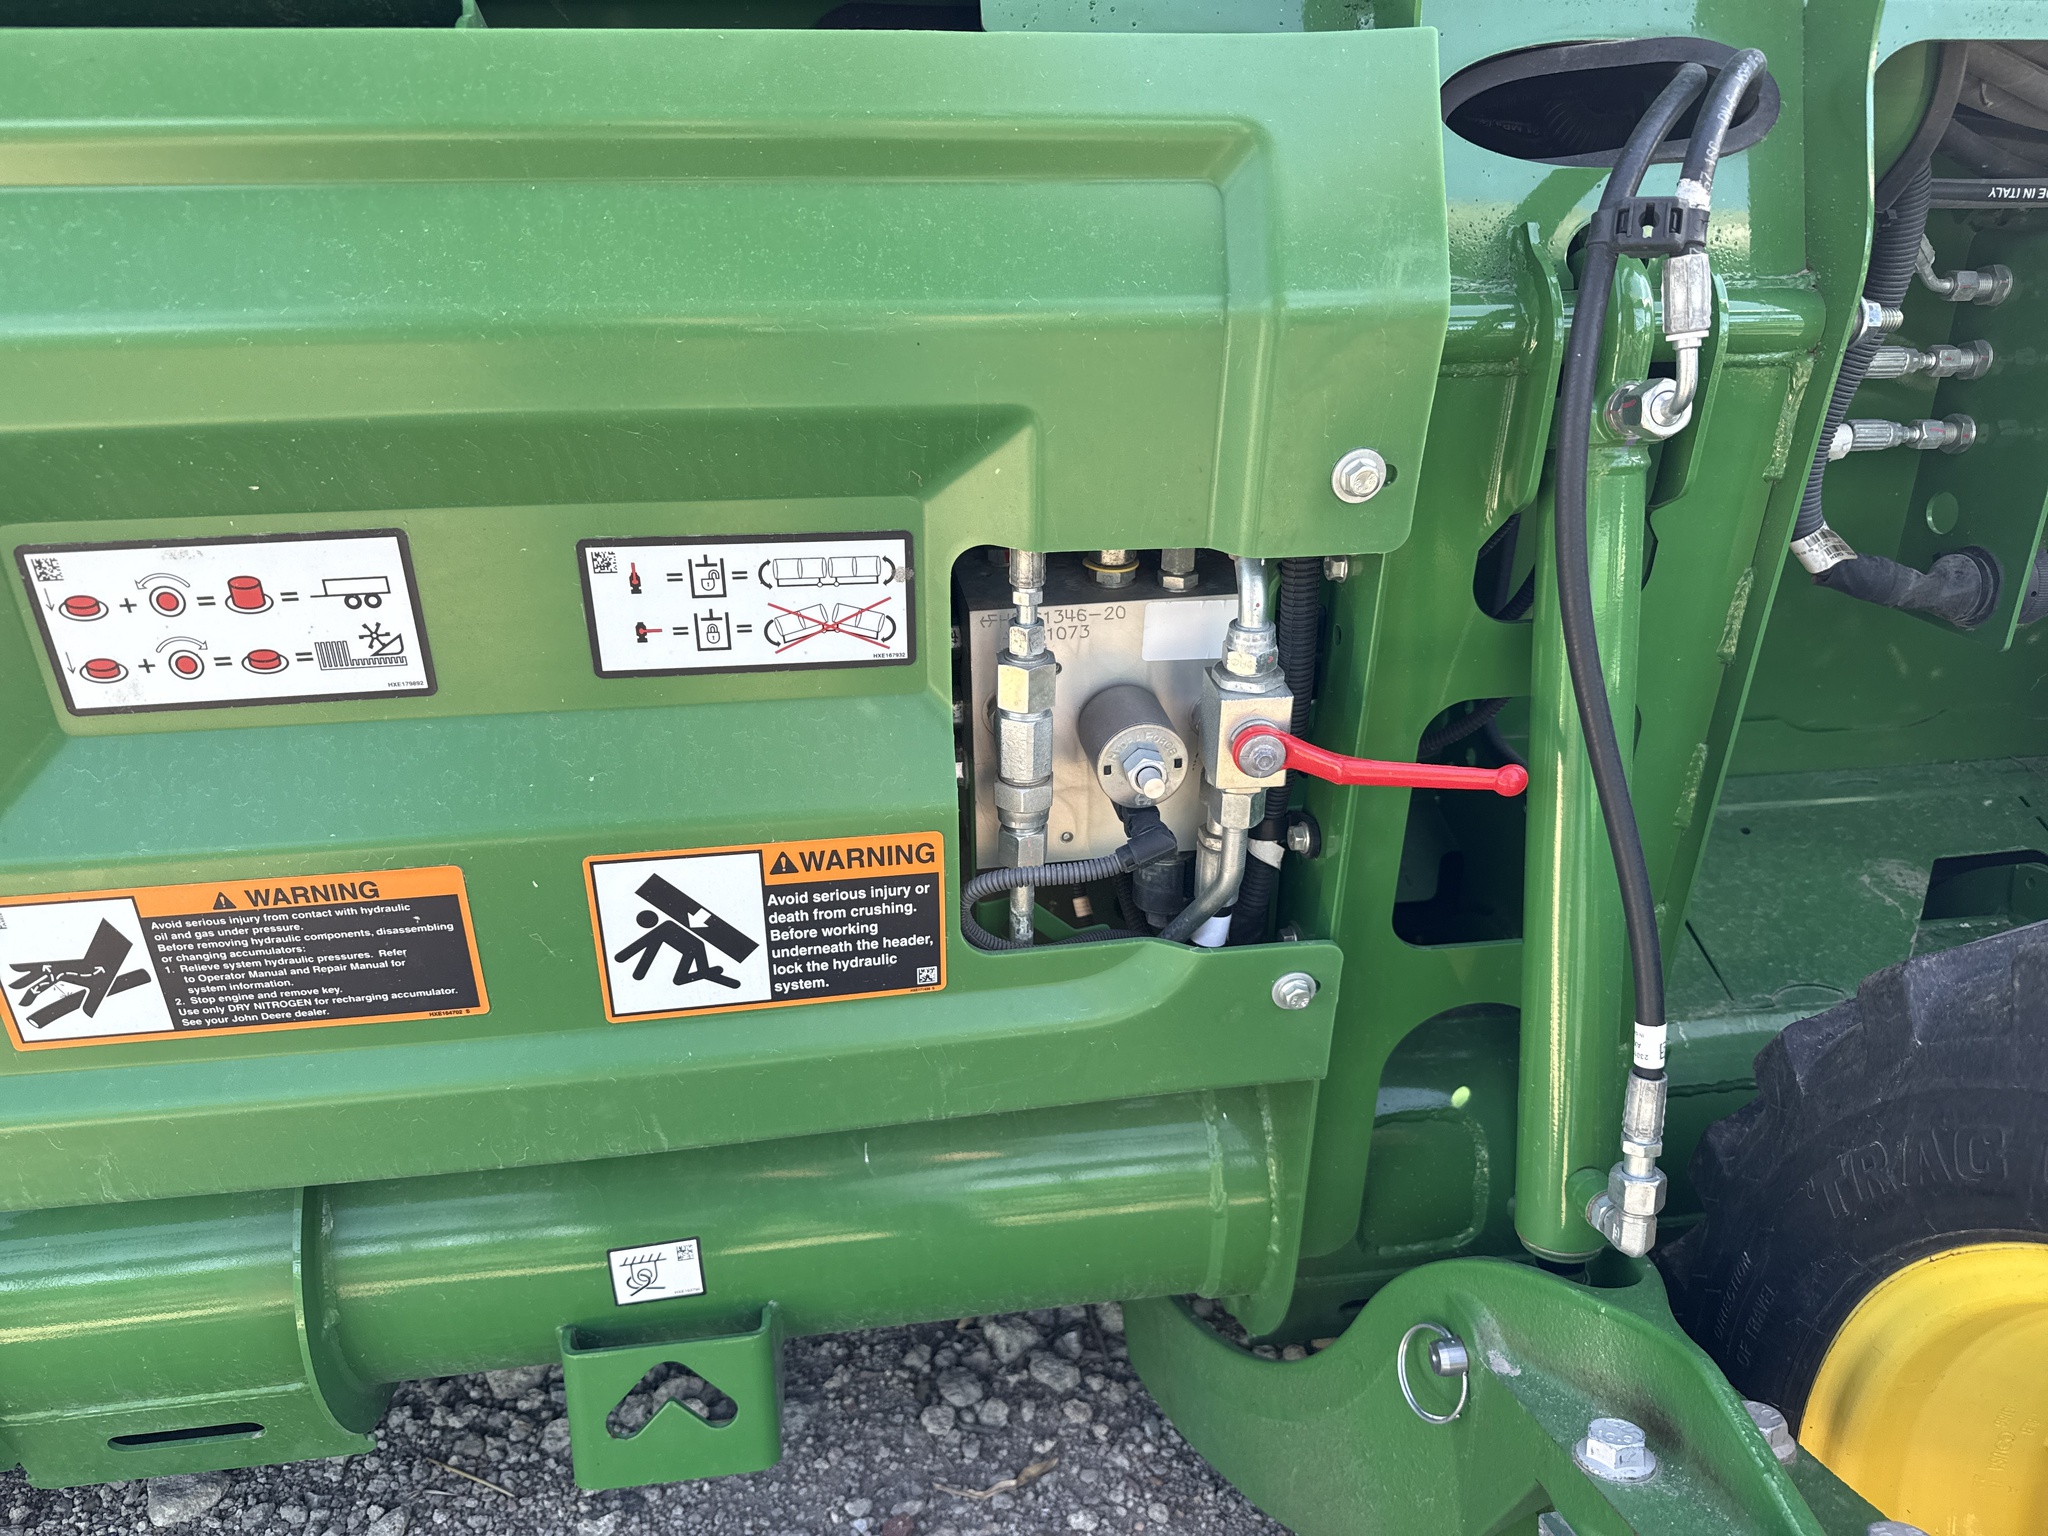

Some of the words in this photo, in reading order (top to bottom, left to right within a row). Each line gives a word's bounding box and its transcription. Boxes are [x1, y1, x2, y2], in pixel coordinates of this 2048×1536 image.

[1987, 186, 2021, 199] ITALY
[2022, 187, 2036, 199] IN
[799, 842, 935, 872] WARNING
[244, 881, 380, 907] WARNING
[767, 891, 809, 907] Avoid
[812, 888, 867, 903] serious
[870, 884, 911, 901] injury
[914, 884, 931, 895] or
[151, 919, 183, 931] Avoid
[184, 917, 227, 928] serious
[228, 915, 261, 926] injury
[262, 913, 289, 922] from
[291, 909, 333, 920] contact
[334, 907, 359, 917] with
[359, 903, 411, 916] hydraulic
[768, 909, 809, 925] death
[812, 908, 847, 921] from
[850, 901, 917, 918] crushing.
[153, 932, 169, 941] oil
[170, 930, 193, 940] and
[194, 930, 215, 941] gas
[217, 927, 249, 937] under
[251, 924, 304, 936] pressure.
[157, 942, 195, 953] Before
[196, 938, 249, 950] removing
[250, 934, 302, 947] hydraulic
[375, 923, 455, 936] disassembling
[770, 925, 818, 942] Before
[821, 921, 879, 937] working
[161, 955, 173, 963] or
[175, 951, 228, 962] changing
[229, 946, 306, 959] accumulators:
[771, 940, 853, 959] underneath
[855, 938, 879, 951] the
[882, 933, 934, 949] header,
[164, 965, 175, 974] 1.
[179, 963, 221, 973] Relieve
[222, 960, 263, 971] system
[263, 955, 315, 968] hydraulic
[316, 952, 374, 965] pressures.
[378, 948, 407, 958] Refer
[183, 975, 196, 984] to
[197, 972, 246, 984] Operator
[247, 967, 288, 979] Manual
[289, 966, 311, 976] and
[312, 963, 348, 975] Repair
[349, 960, 389, 971] Manual
[390, 959, 406, 967] for
[772, 961, 804, 976] lock
[805, 960, 829, 973] the
[832, 953, 898, 972] hydraulic
[174, 997, 186, 1006] 2.
[189, 996, 216, 1005] Stop
[217, 993, 255, 1003] engine
[257, 990, 278, 1000] and
[279, 988, 320, 998] remove
[321, 986, 343, 995] key.
[187, 985, 227, 996] system
[228, 979, 294, 991] information.
[774, 978, 830, 995] system.
[177, 1007, 200, 1017] Use
[201, 1005, 225, 1015] only
[227, 1003, 251, 1013] DRY
[253, 998, 313, 1011] NITROGEN
[313, 997, 330, 1006] for
[331, 993, 389, 1004] recharging
[391, 987, 459, 1000] accumulator.
[181, 1018, 203, 1027] See
[204, 1016, 229, 1027] your
[231, 1013, 259, 1023] John
[260, 1011, 292, 1021] Deere
[294, 1008, 330, 1018] dealer.
[1806, 1124, 2008, 1218] TRAC
[1713, 1250, 1752, 1339] DIRECTION
[1736, 1339, 1752, 1366] OF
[1745, 1283, 1779, 1340] TRAVEL
